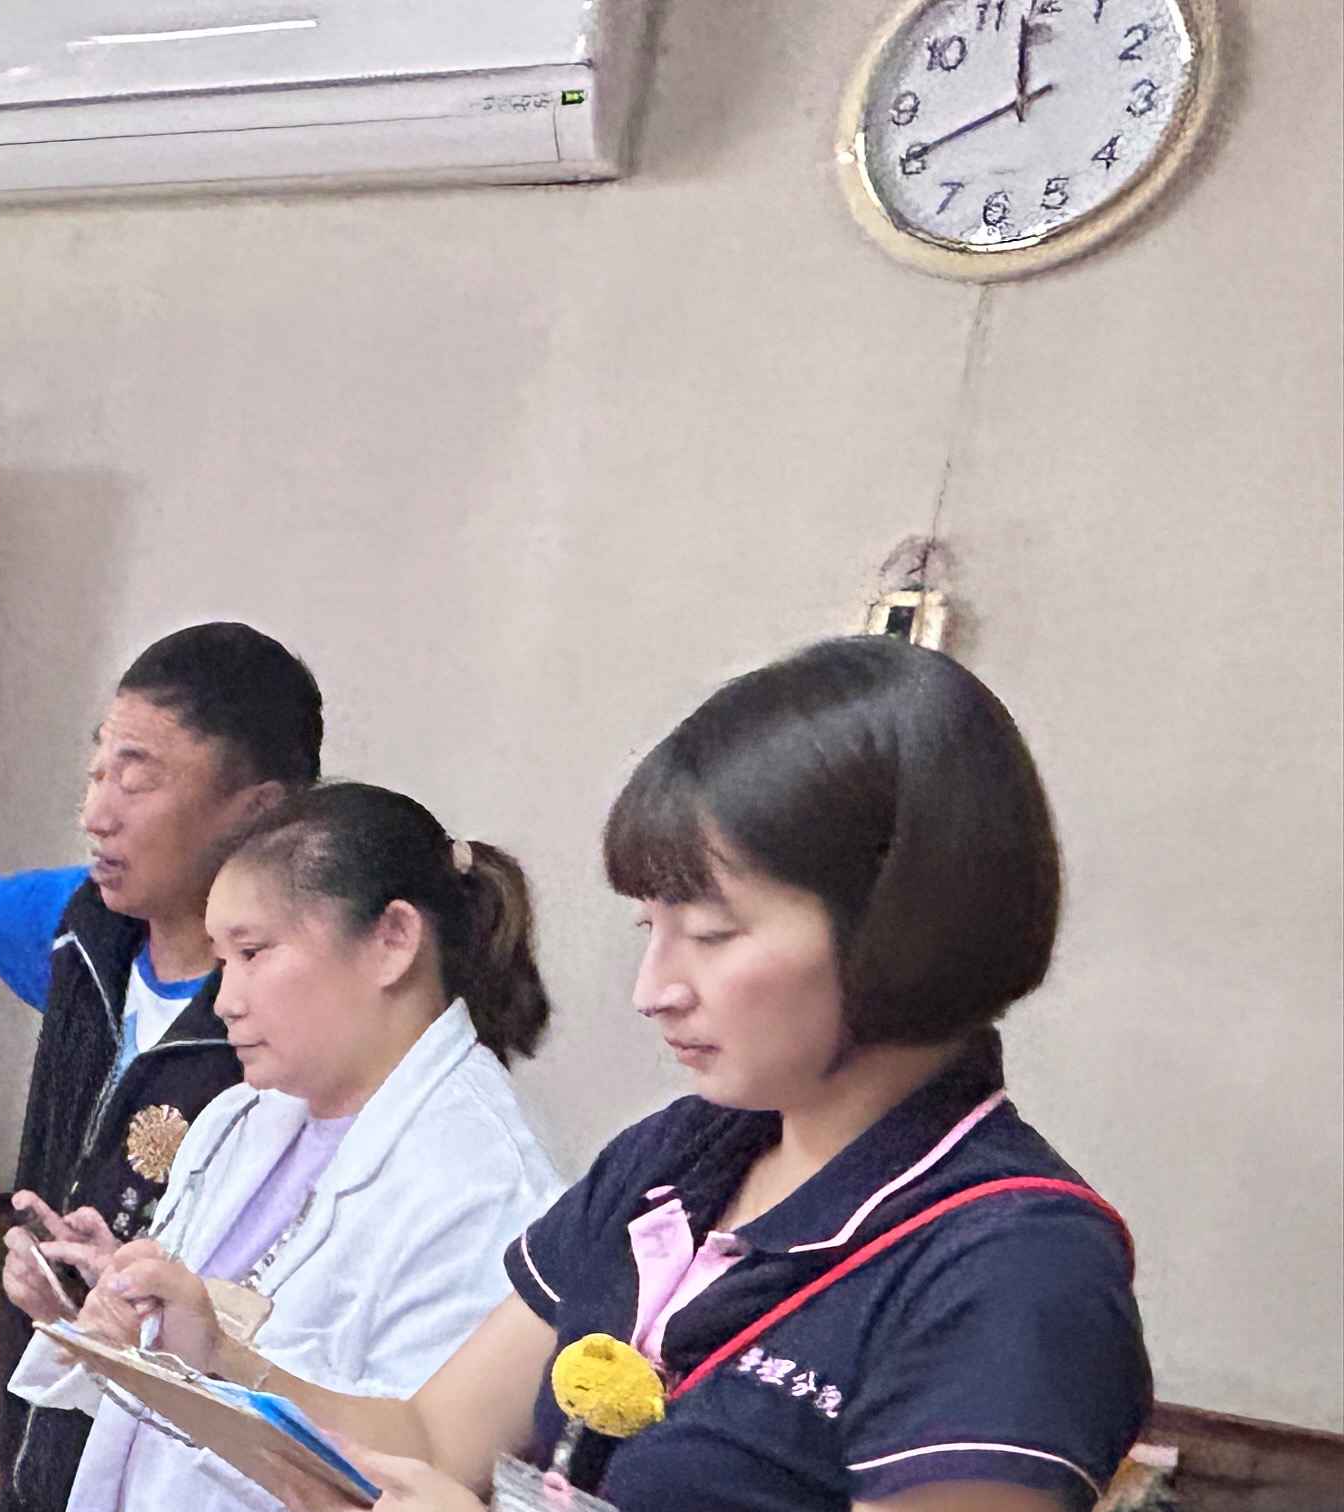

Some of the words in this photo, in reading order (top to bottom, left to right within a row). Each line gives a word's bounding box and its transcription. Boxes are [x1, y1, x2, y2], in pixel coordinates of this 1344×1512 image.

[925, 34, 968, 72] 10
[1118, 23, 1152, 61] 2
[890, 90, 921, 126] 9
[1125, 79, 1158, 118] 3
[1091, 134, 1123, 170] 4
[935, 181, 965, 215] 7
[982, 190, 1011, 229] 6
[1041, 176, 1070, 210] 5
